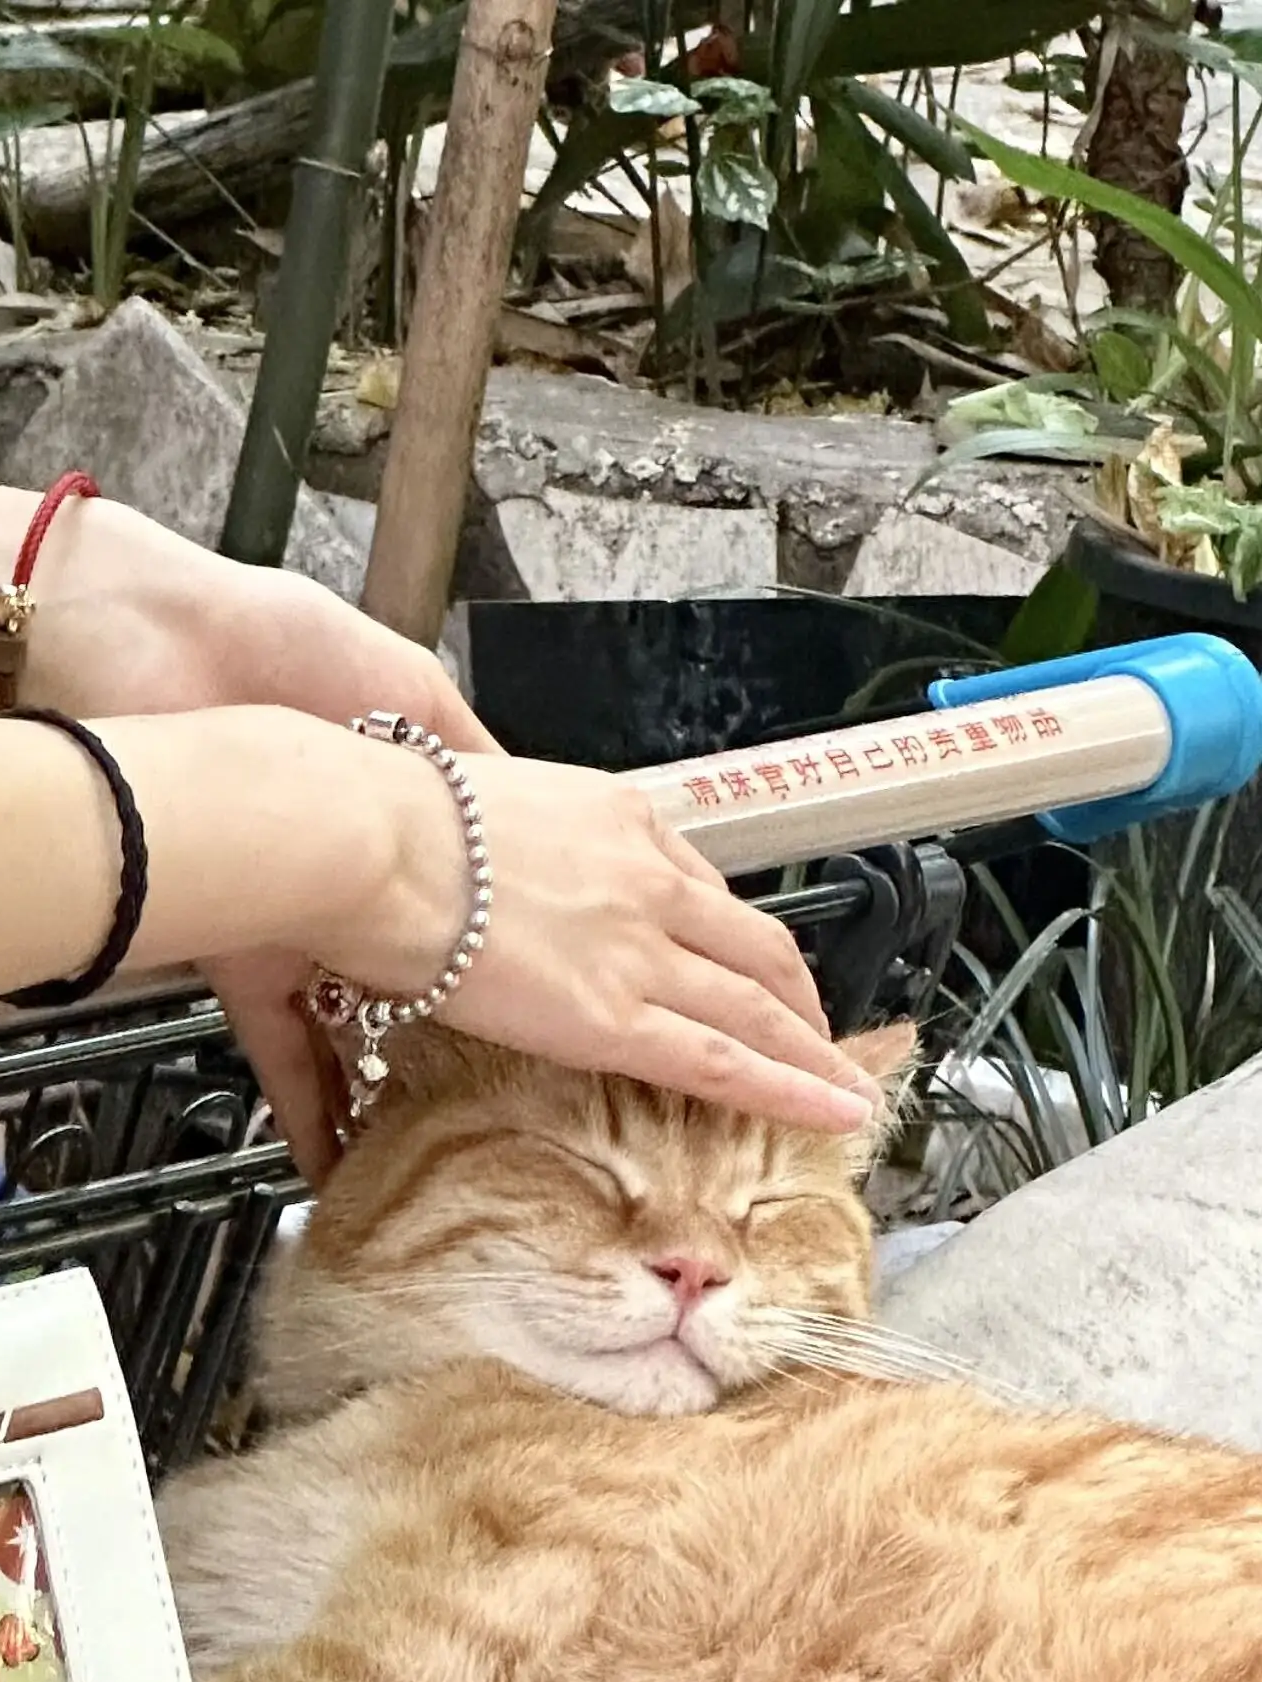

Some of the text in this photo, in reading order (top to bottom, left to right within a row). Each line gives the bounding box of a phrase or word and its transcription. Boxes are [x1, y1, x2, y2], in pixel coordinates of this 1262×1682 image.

[682, 706, 1064, 806] 请保管好自己的贵重物品
